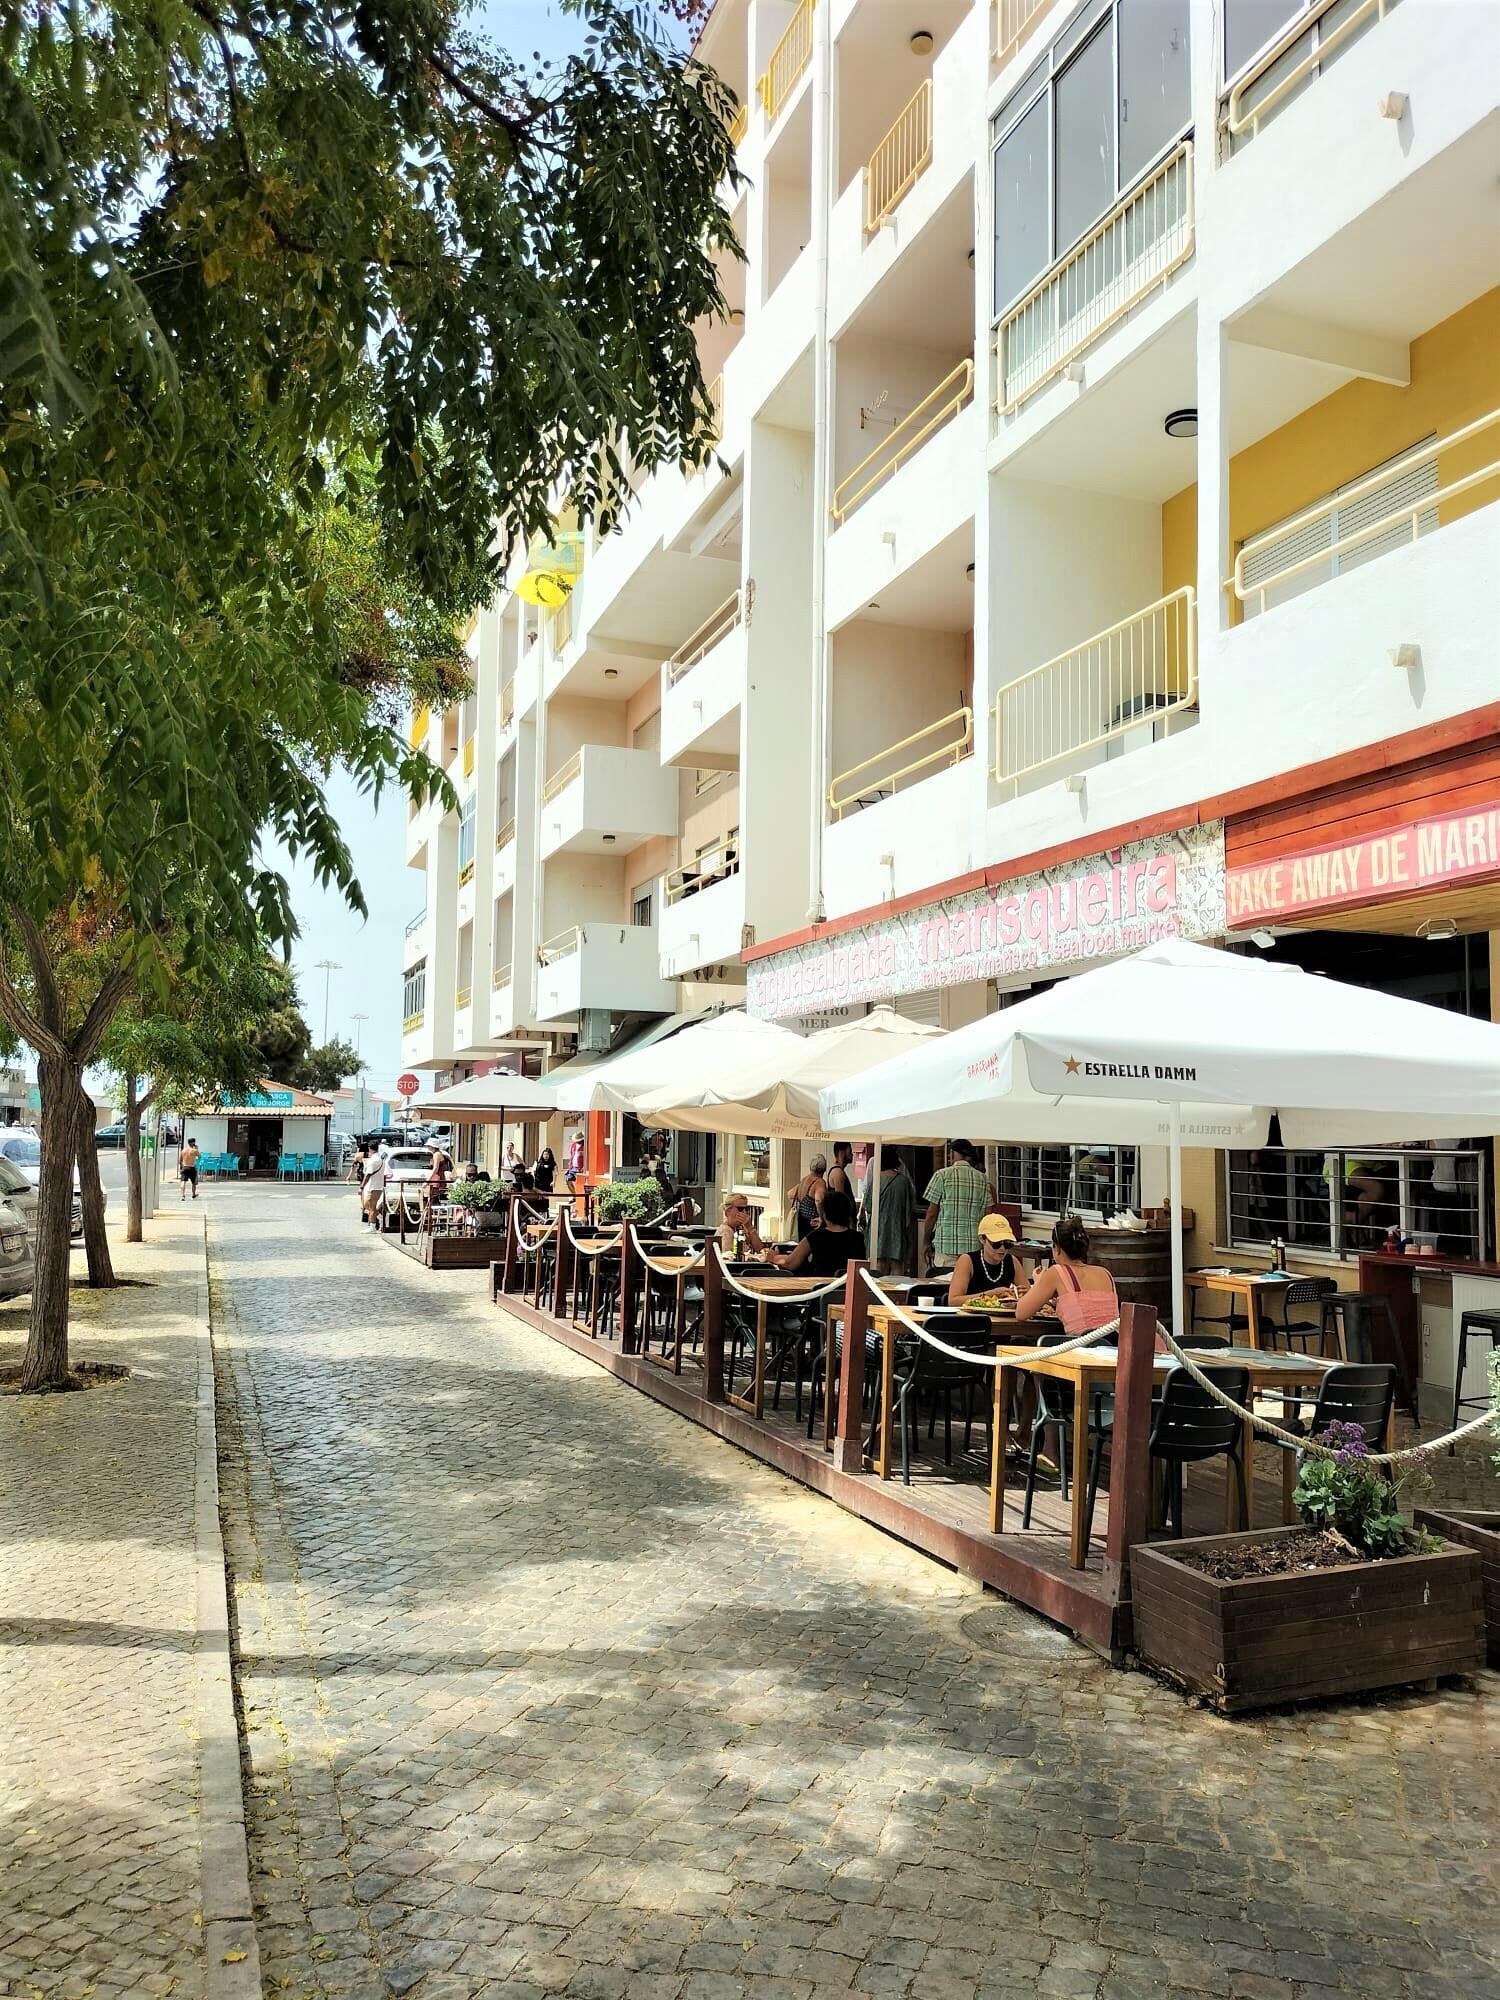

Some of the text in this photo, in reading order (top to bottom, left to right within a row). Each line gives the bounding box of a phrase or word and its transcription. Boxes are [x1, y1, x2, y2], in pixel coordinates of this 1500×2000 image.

[1227, 863, 1285, 917] TAKE
[1291, 847, 1362, 903] AWAY
[1371, 832, 1408, 886] DE
[919, 849, 1179, 964] marisqueira
[1053, 912, 1184, 959] seafood market
[398, 1080, 420, 1090] STOP
[1085, 1062, 1197, 1081] ESTRELLA DAMM
